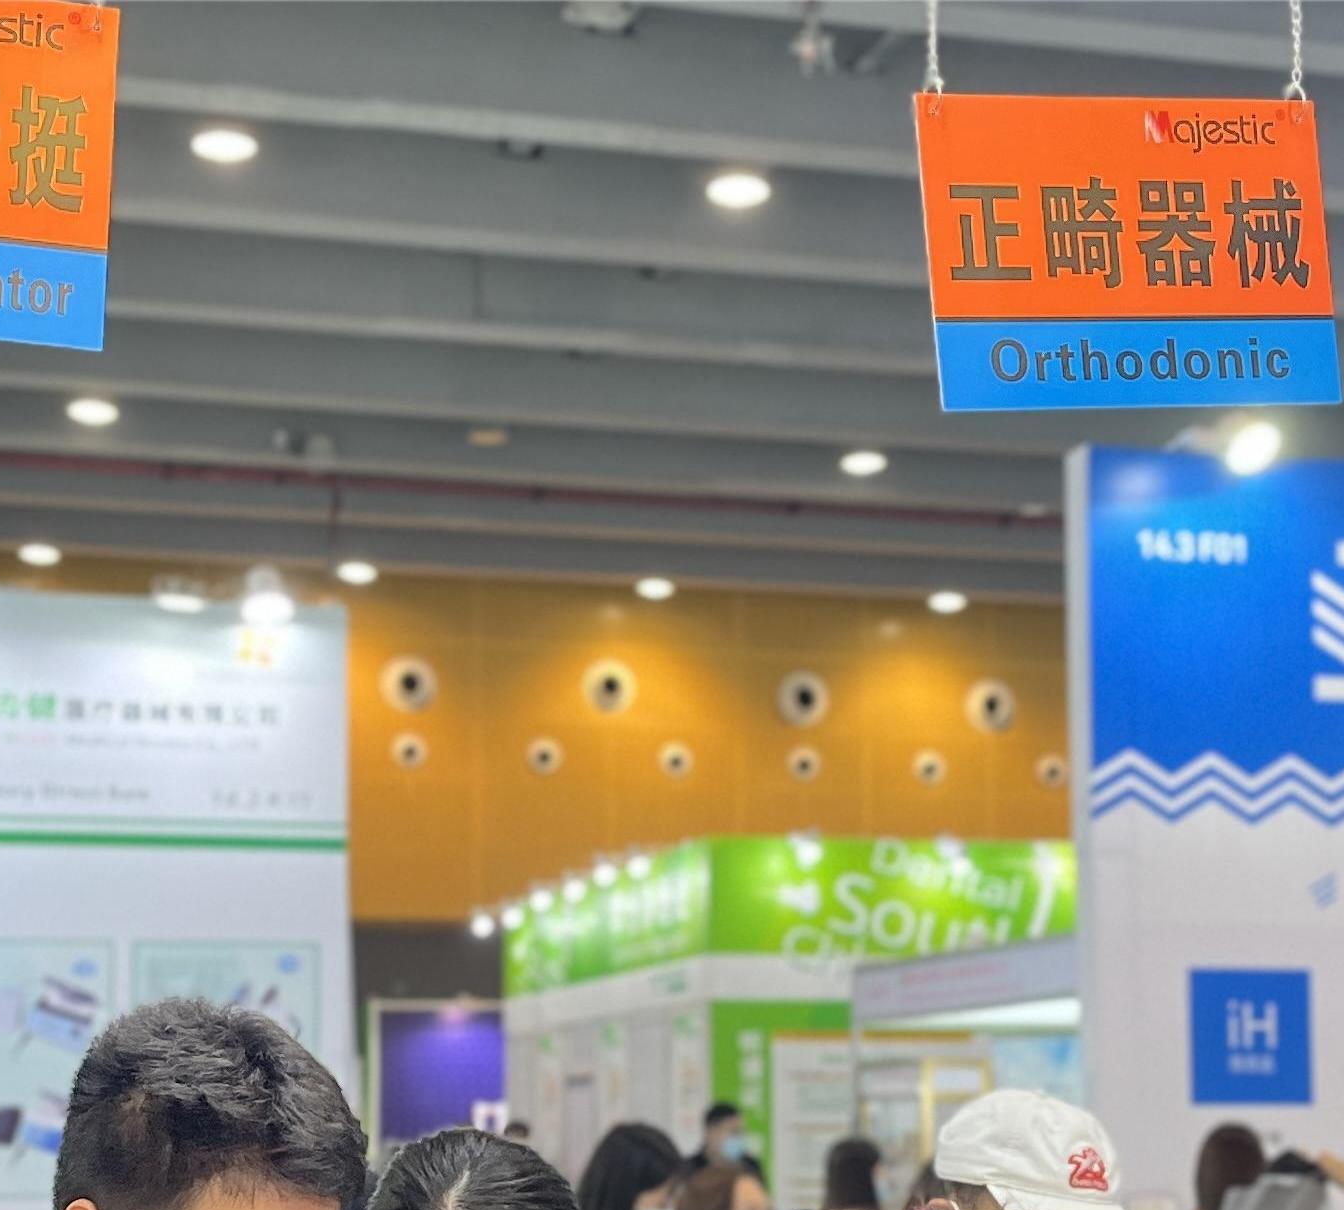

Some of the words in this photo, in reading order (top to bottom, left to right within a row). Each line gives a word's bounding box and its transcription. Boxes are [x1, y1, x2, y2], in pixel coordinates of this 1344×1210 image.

[1144, 110, 1276, 153] Majestic
[948, 176, 1311, 289] 正畸器械
[990, 337, 1291, 382] Orthodonic
